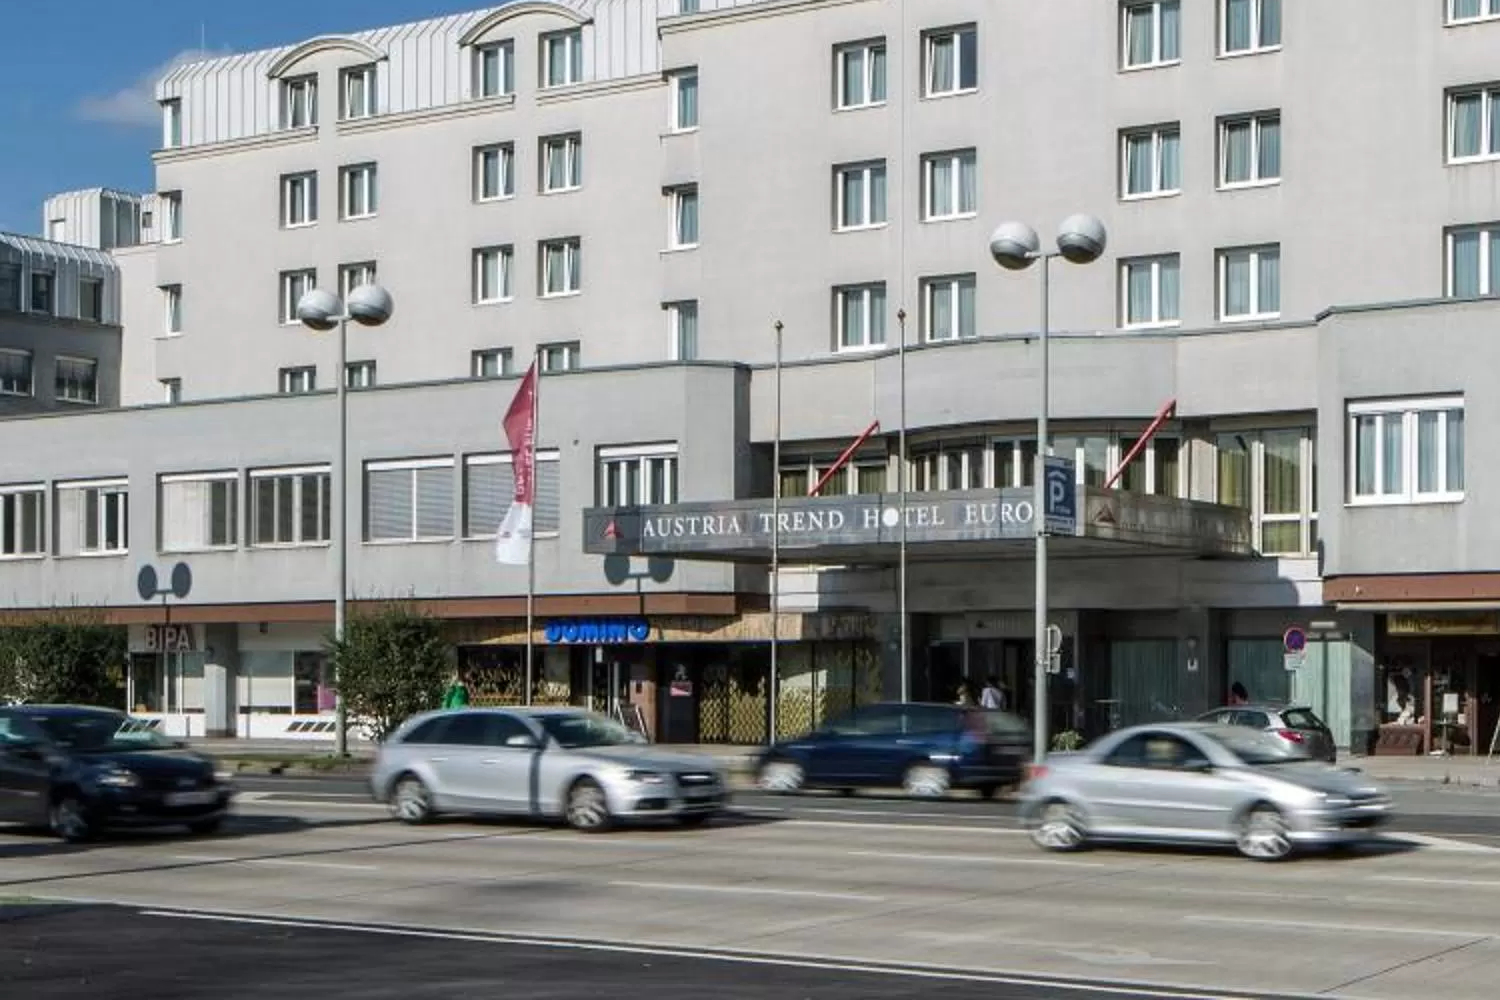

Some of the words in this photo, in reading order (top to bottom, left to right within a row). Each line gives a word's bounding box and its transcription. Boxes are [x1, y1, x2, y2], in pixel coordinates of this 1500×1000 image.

[642, 513, 742, 537] AUSTRIA
[759, 510, 845, 534] TREND
[964, 500, 1034, 525] EURO
[145, 627, 190, 650] BIPA
